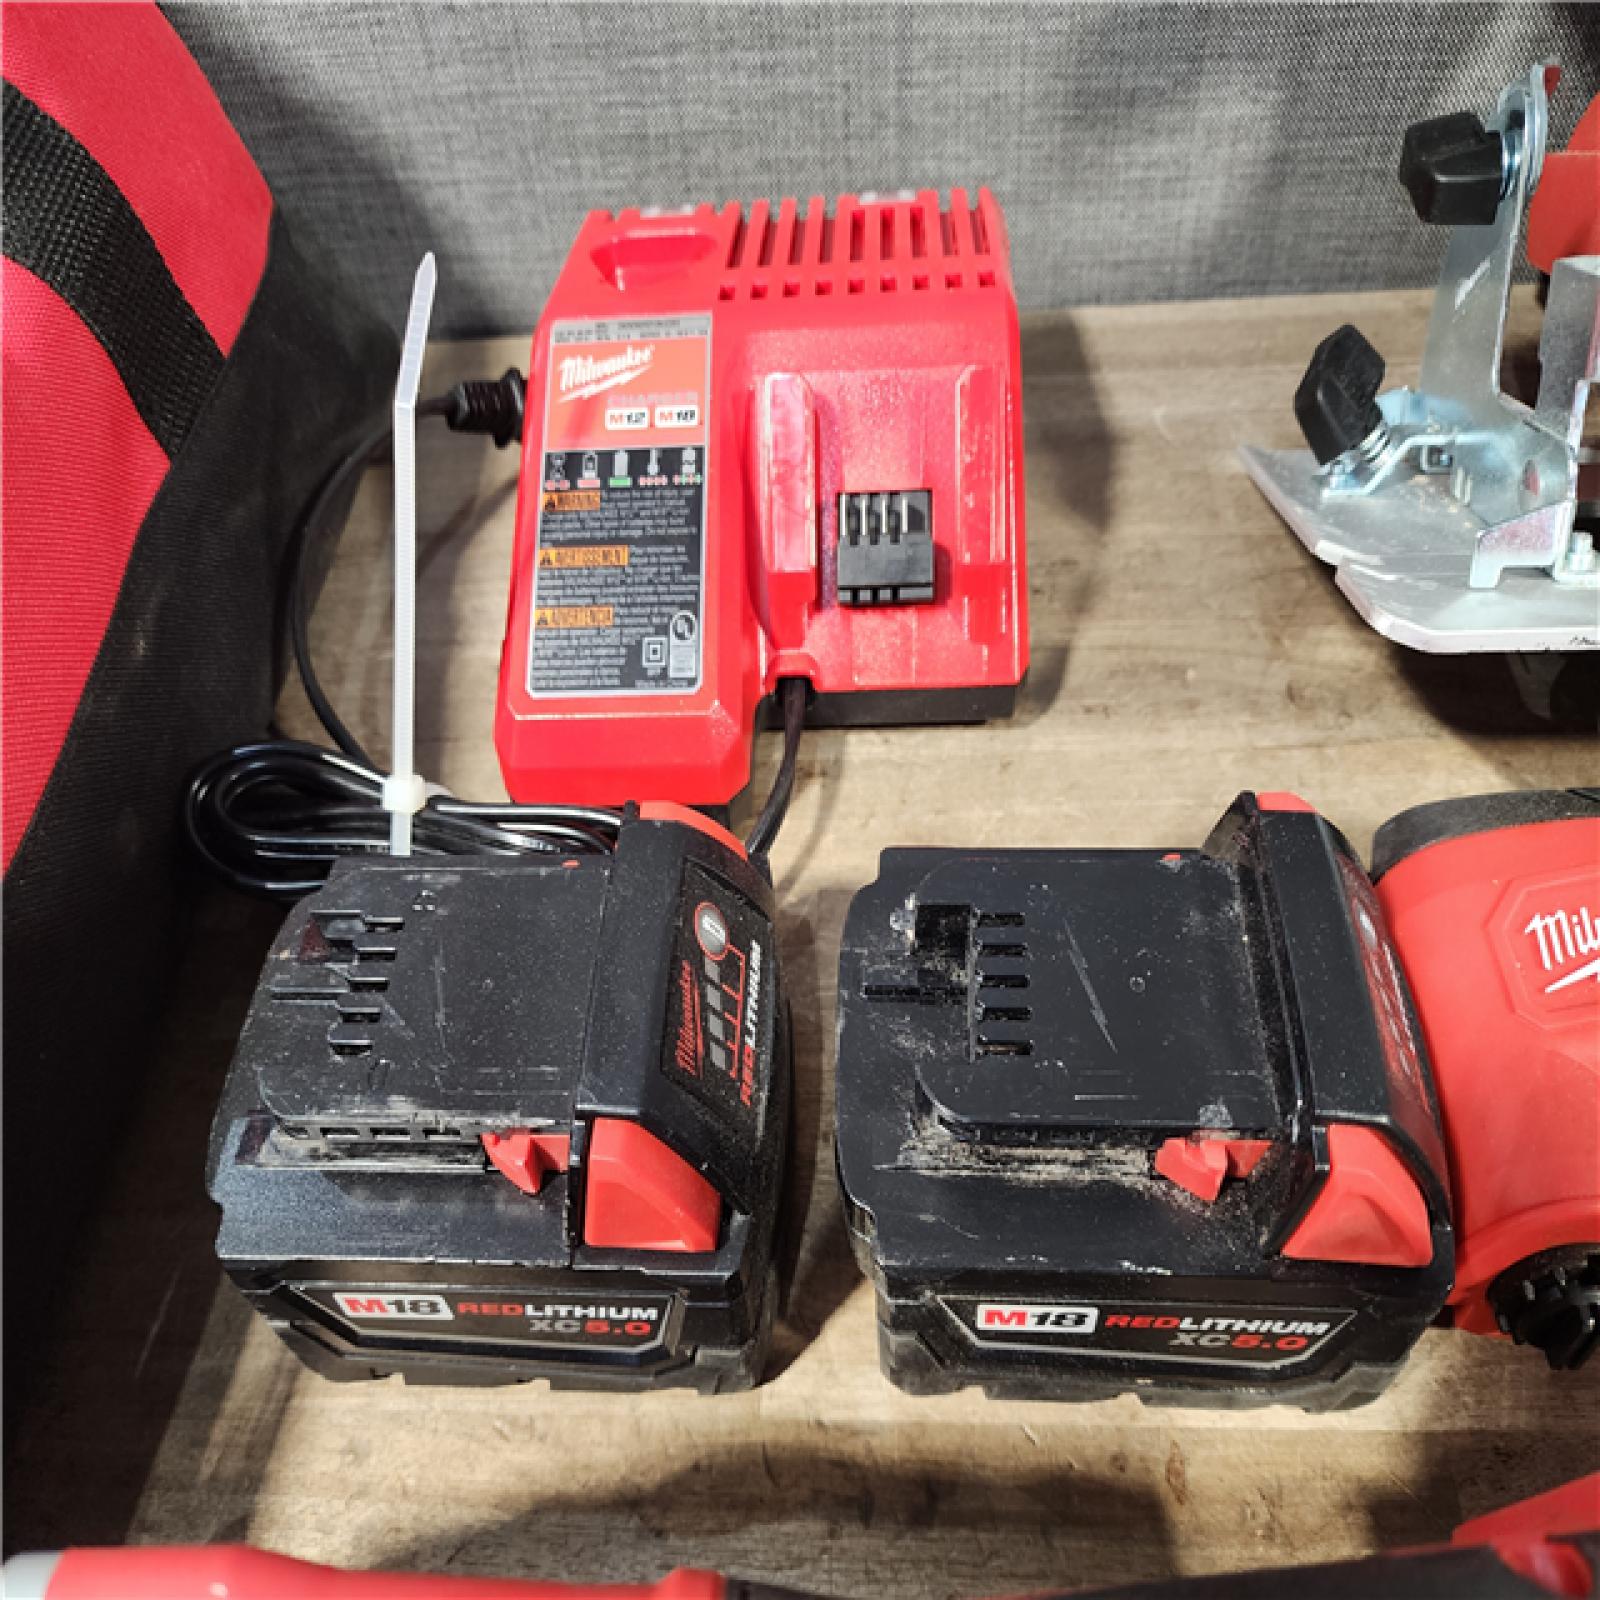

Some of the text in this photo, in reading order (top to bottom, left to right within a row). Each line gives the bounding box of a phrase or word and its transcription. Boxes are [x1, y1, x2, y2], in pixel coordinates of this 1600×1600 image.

[560, 345, 653, 391] Milwaukee
[739, 938, 761, 1107] REDLITHIUM
[344, 1297, 659, 1321] M18 REDLITHIUM
[983, 1309, 1331, 1336] M18 REDLITHIUM
